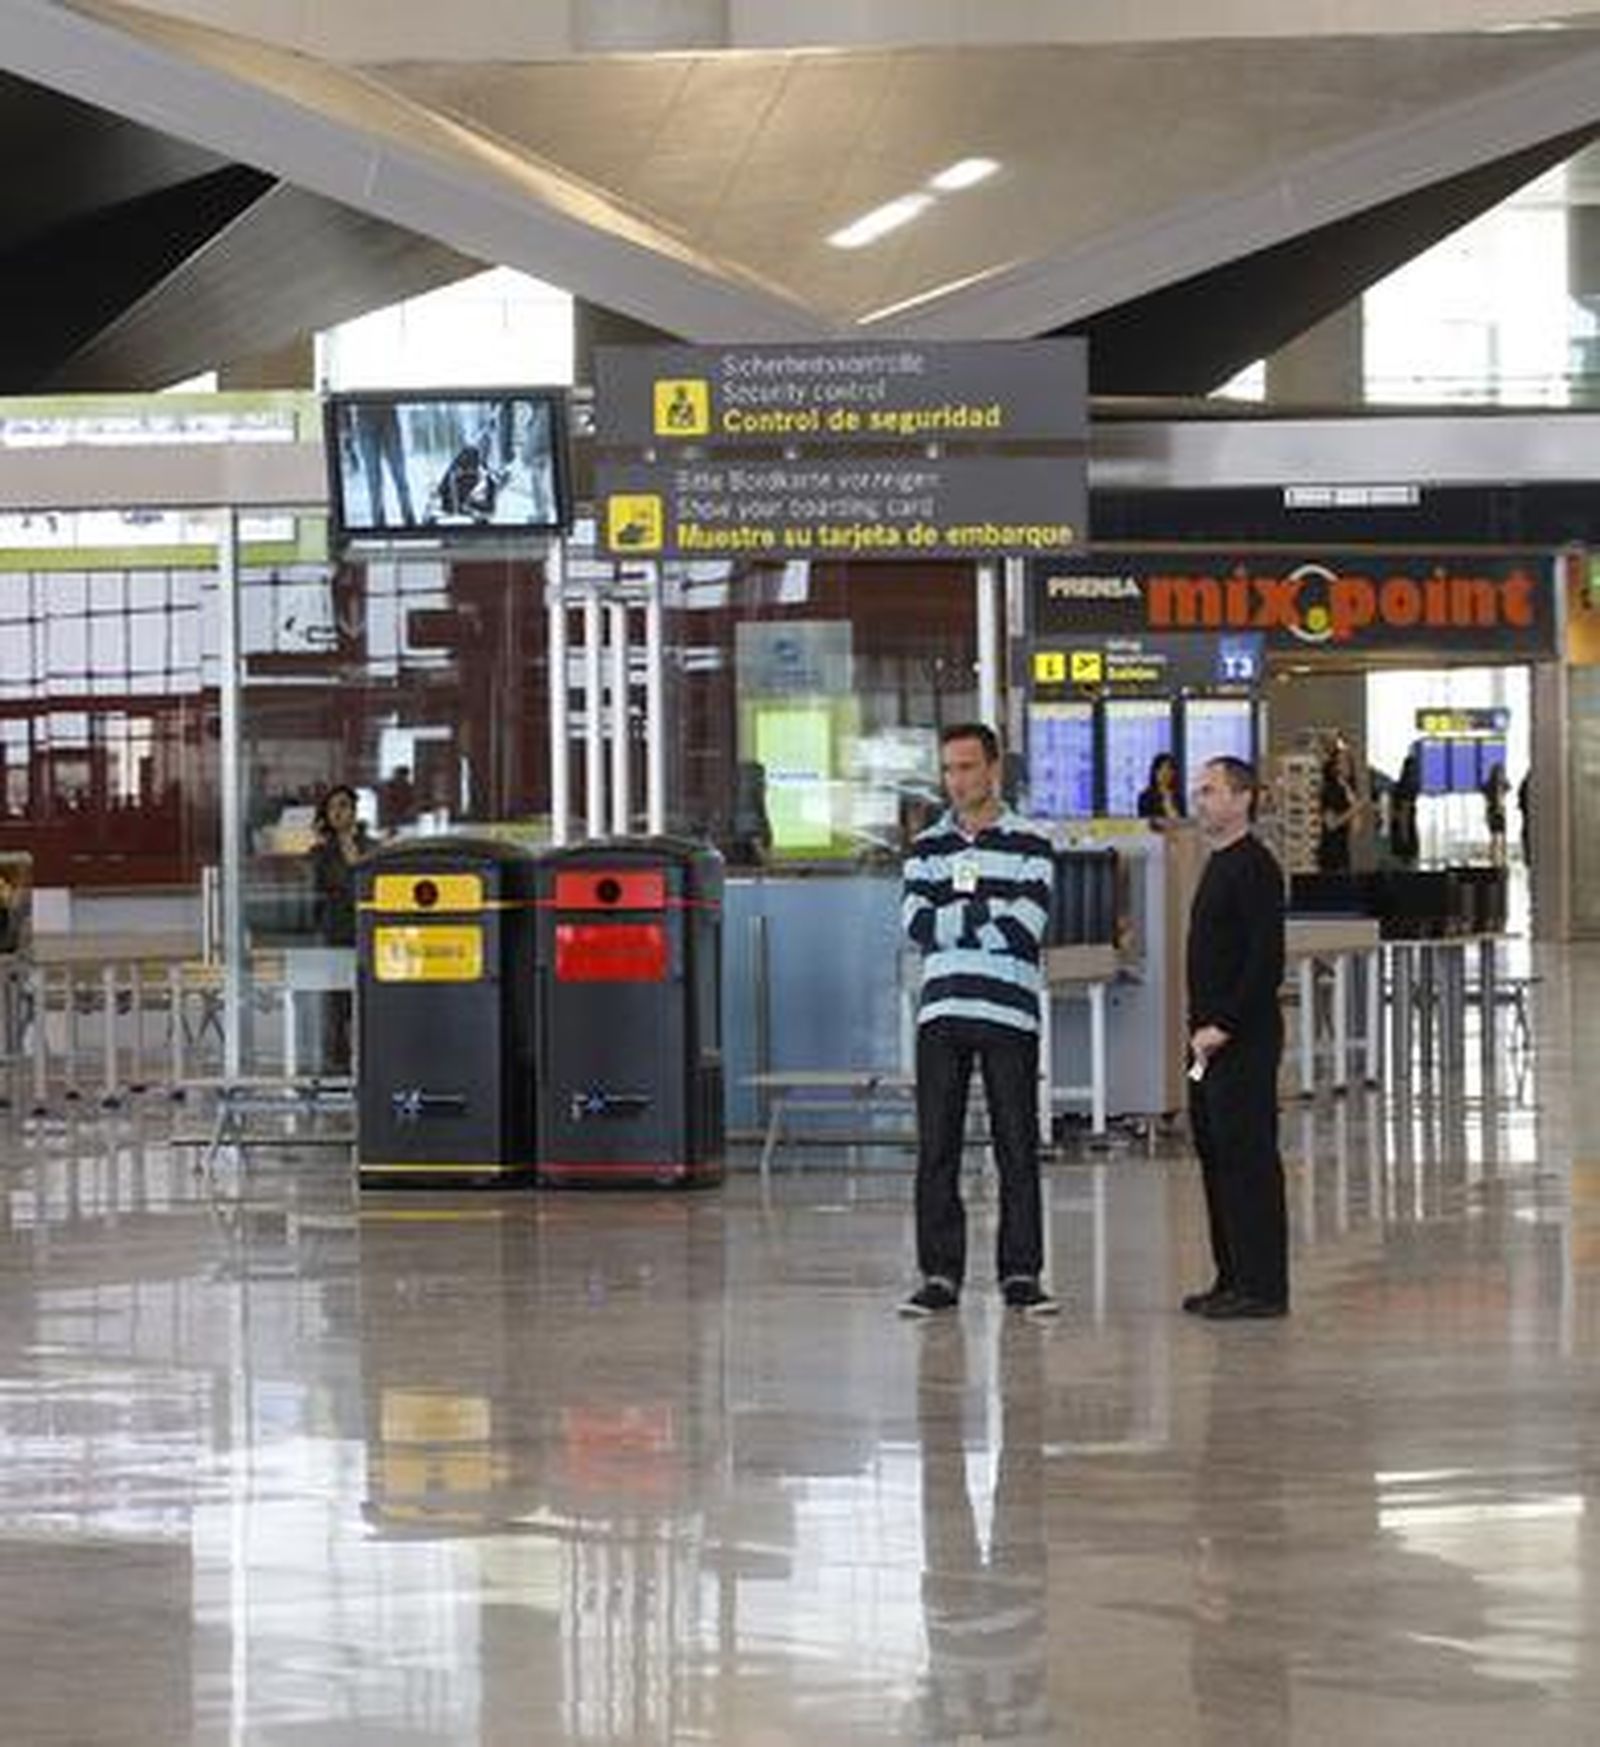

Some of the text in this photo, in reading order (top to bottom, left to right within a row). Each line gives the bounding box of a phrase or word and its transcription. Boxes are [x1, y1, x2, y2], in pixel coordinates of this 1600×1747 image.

[722, 377, 886, 405] Security control
[722, 402, 1001, 435] Control de seguridad
[784, 526, 812, 547] su
[817, 523, 901, 550] tarjeta
[906, 521, 940, 547] de
[946, 522, 1074, 550] embarque
